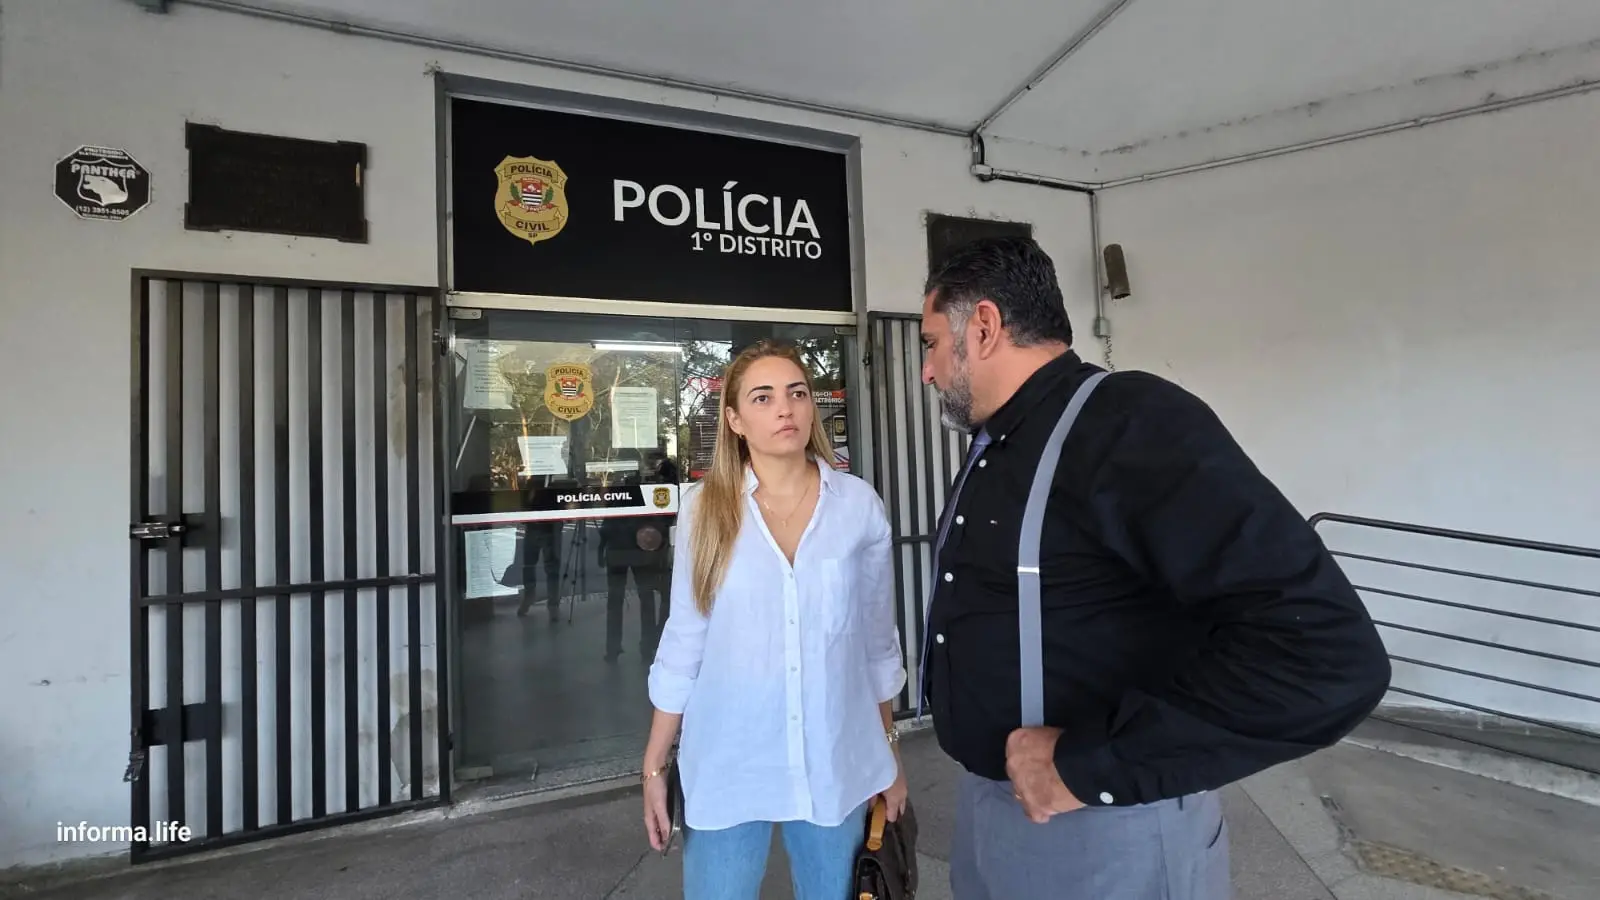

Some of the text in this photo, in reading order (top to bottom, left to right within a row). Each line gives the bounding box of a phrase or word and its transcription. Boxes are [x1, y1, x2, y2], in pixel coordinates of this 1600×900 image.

[71, 163, 136, 179] PANTHER
[75, 205, 91, 213] (12)
[613, 179, 821, 239] POLÍCIA
[515, 220, 550, 231] CIVIL
[719, 233, 822, 260] DISTRITO
[558, 406, 581, 414] CIVIL
[556, 491, 633, 503] POLÍCIA CIVIL
